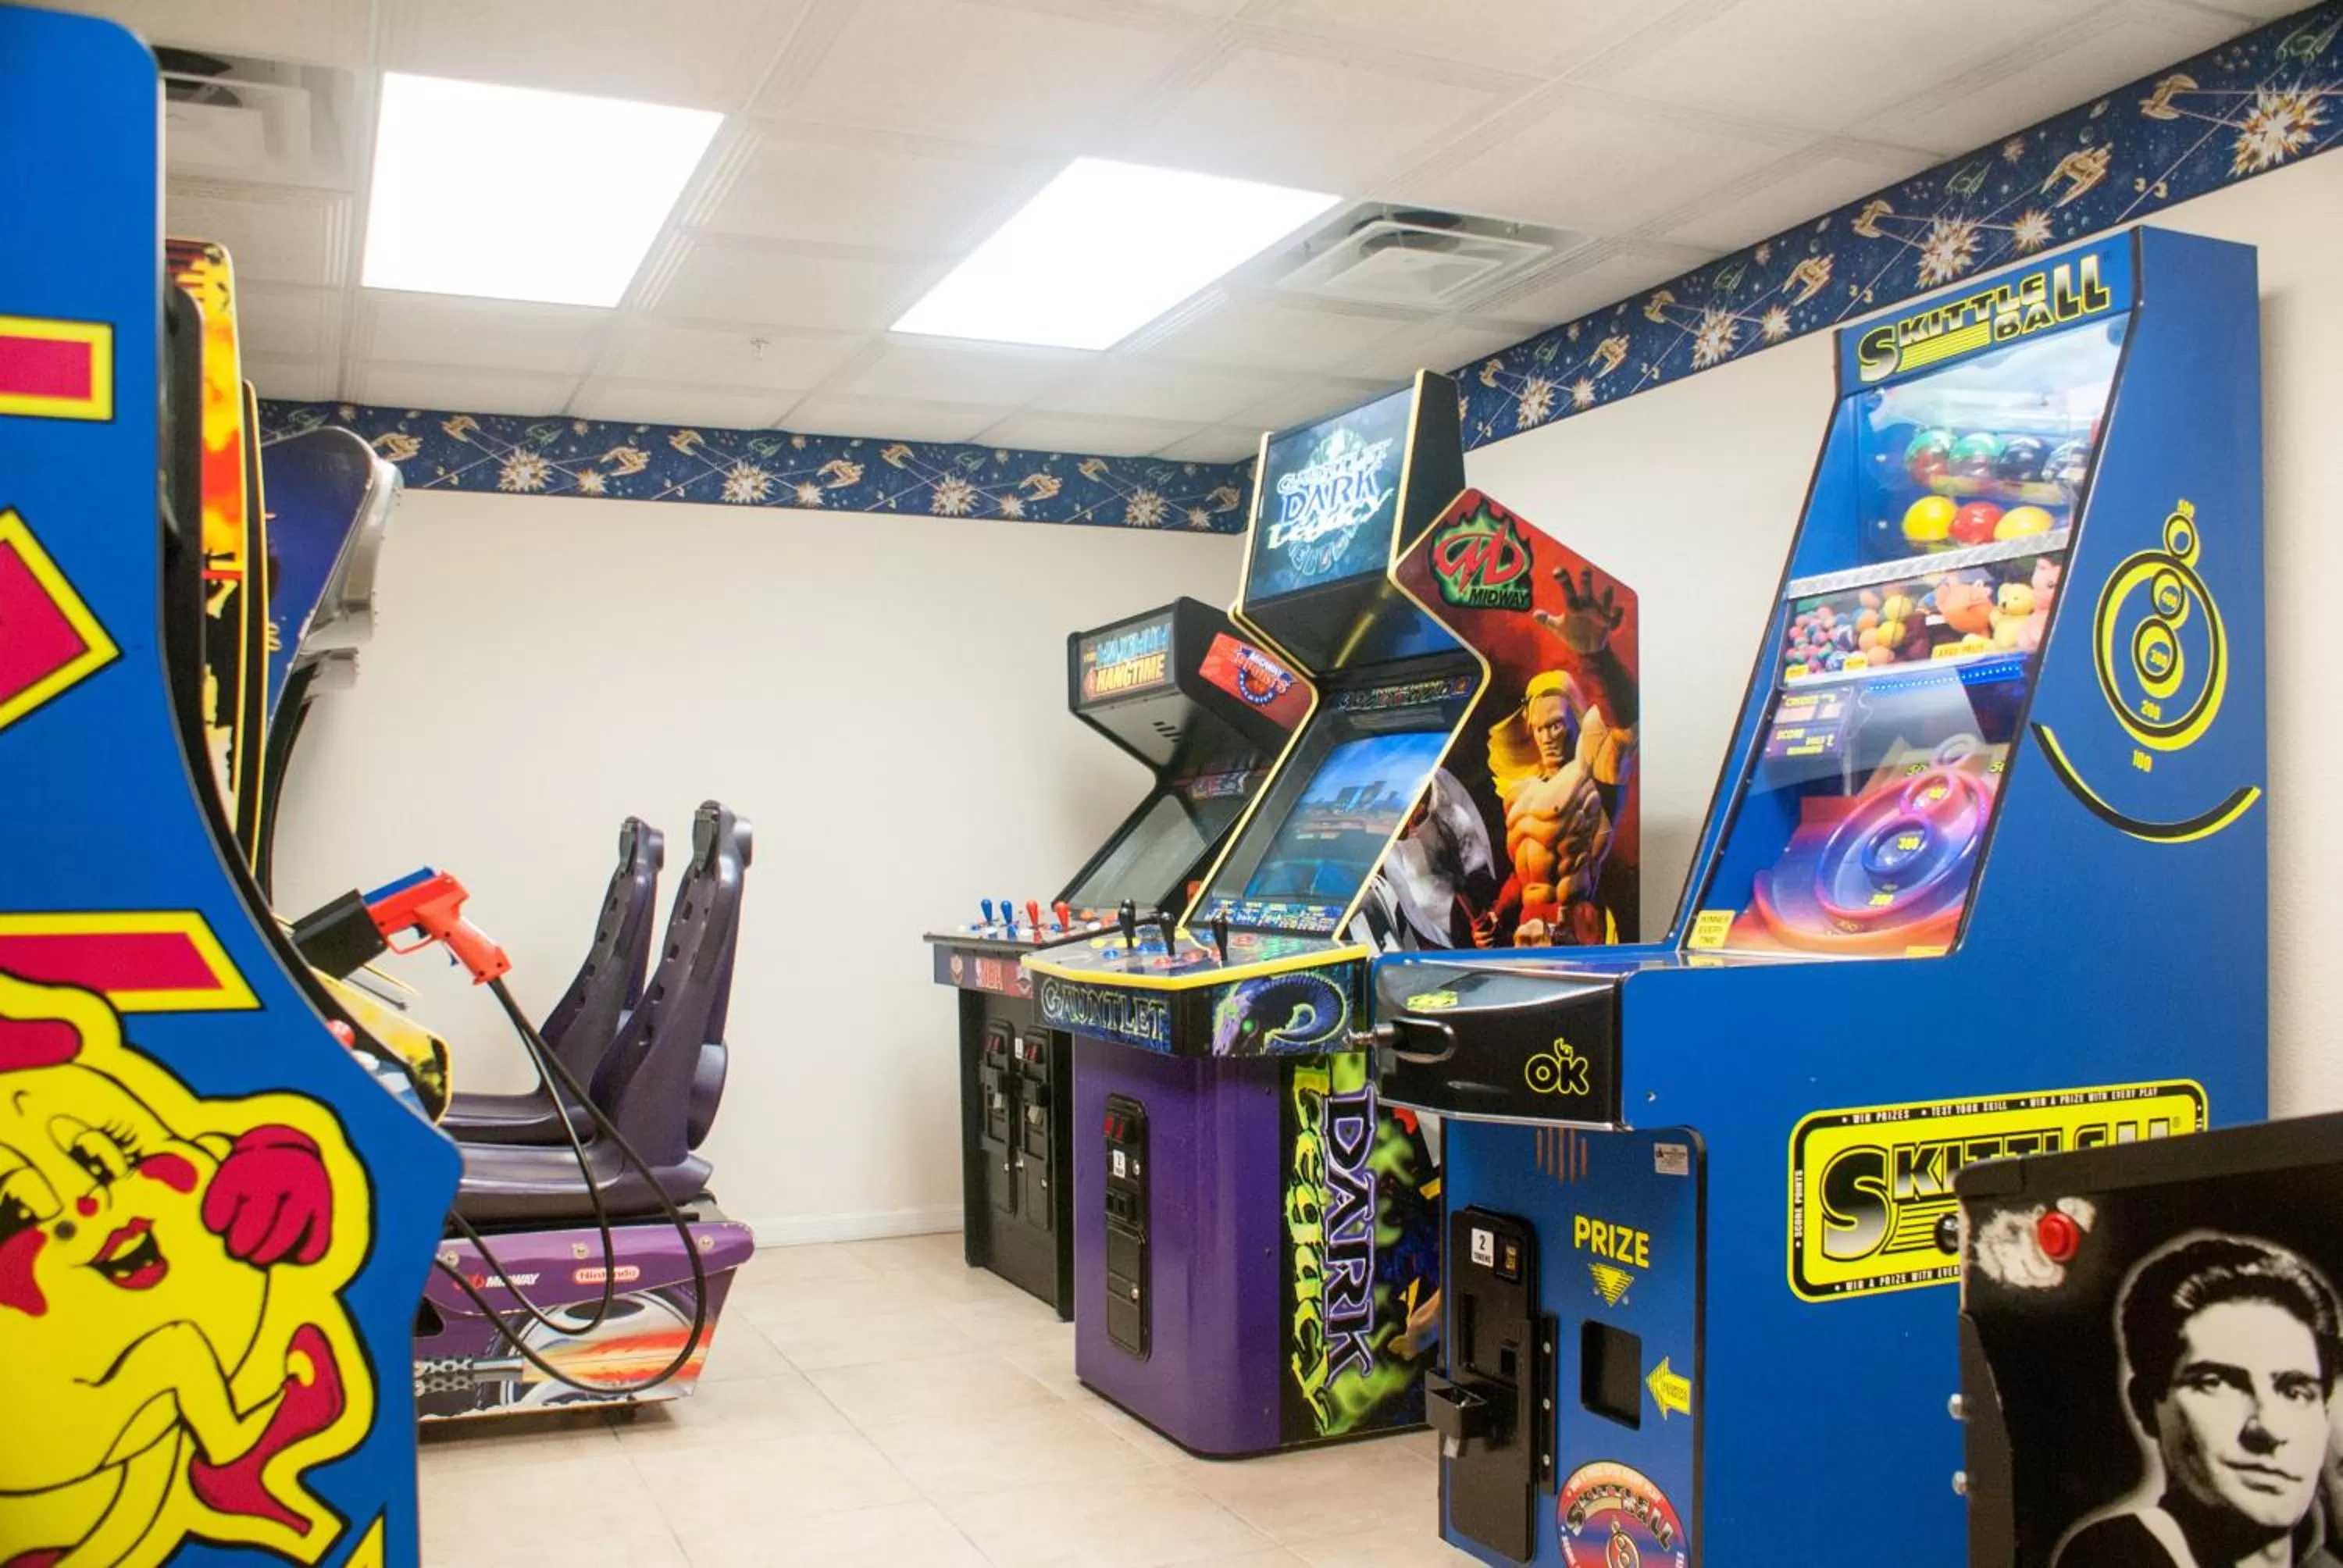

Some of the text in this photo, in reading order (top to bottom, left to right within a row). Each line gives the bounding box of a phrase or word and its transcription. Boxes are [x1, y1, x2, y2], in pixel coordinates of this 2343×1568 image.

[1994, 253, 2111, 341] BALL
[1858, 272, 2046, 381] SKITTLE
[1278, 463, 1383, 528] DARK
[1468, 587, 1531, 608] MIDWAY
[1040, 976, 1167, 1040] GAUNTLET
[1876, 1110, 1910, 1122] PRIZES
[1323, 1082, 1379, 1388] DARK
[1478, 1234, 1487, 1251] 2
[1574, 1214, 1650, 1269] PRIZE
[486, 1272, 540, 1288] MIWAY
[580, 1269, 637, 1281] Nintndo
